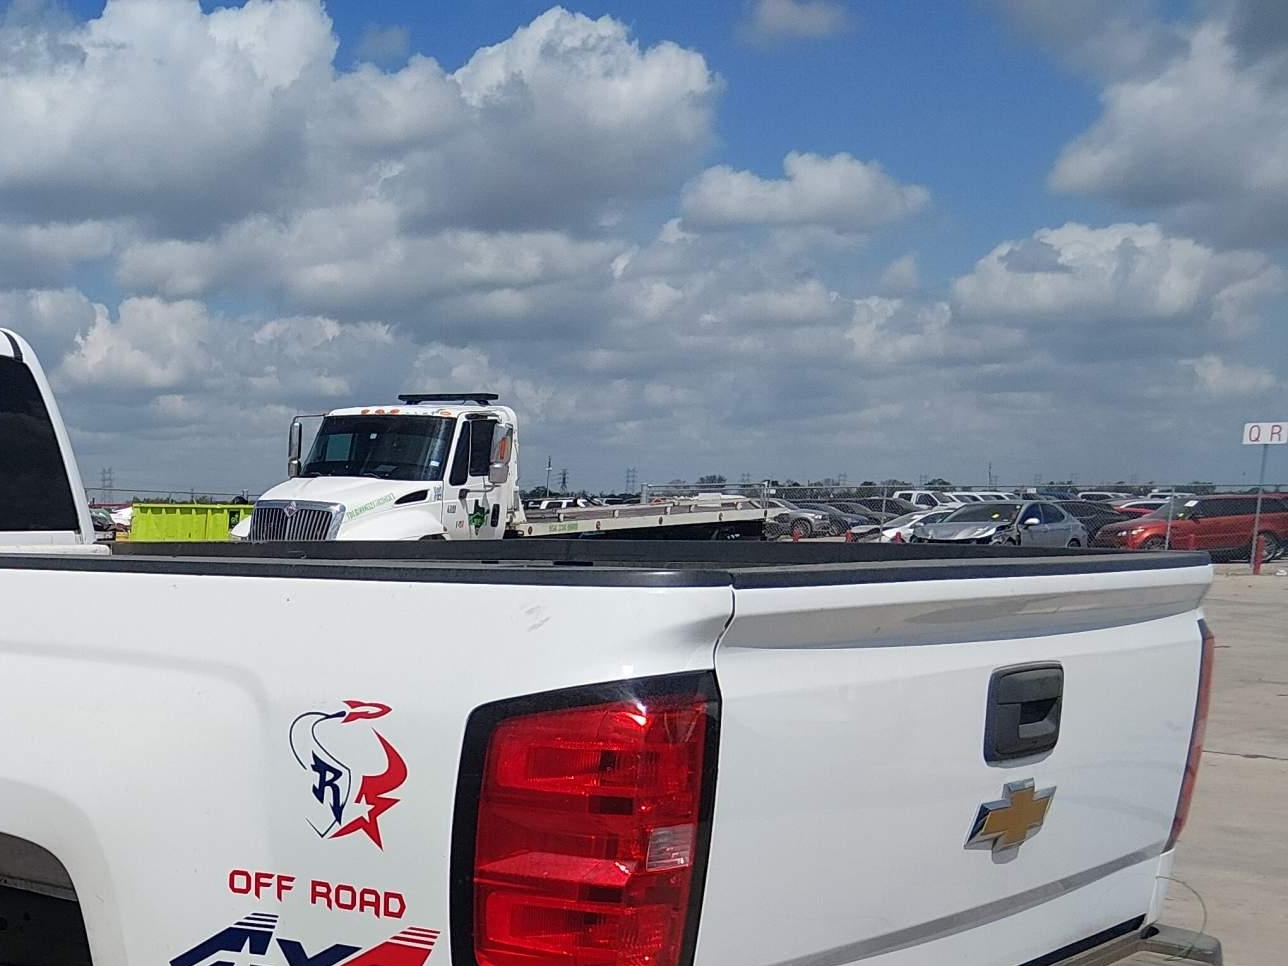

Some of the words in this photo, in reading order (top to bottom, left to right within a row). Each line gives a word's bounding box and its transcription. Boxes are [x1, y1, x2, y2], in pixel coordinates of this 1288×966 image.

[1248, 424, 1261, 442] Q
[1270, 424, 1282, 442] R
[228, 868, 296, 902] OFF
[311, 879, 407, 920] ROAD
